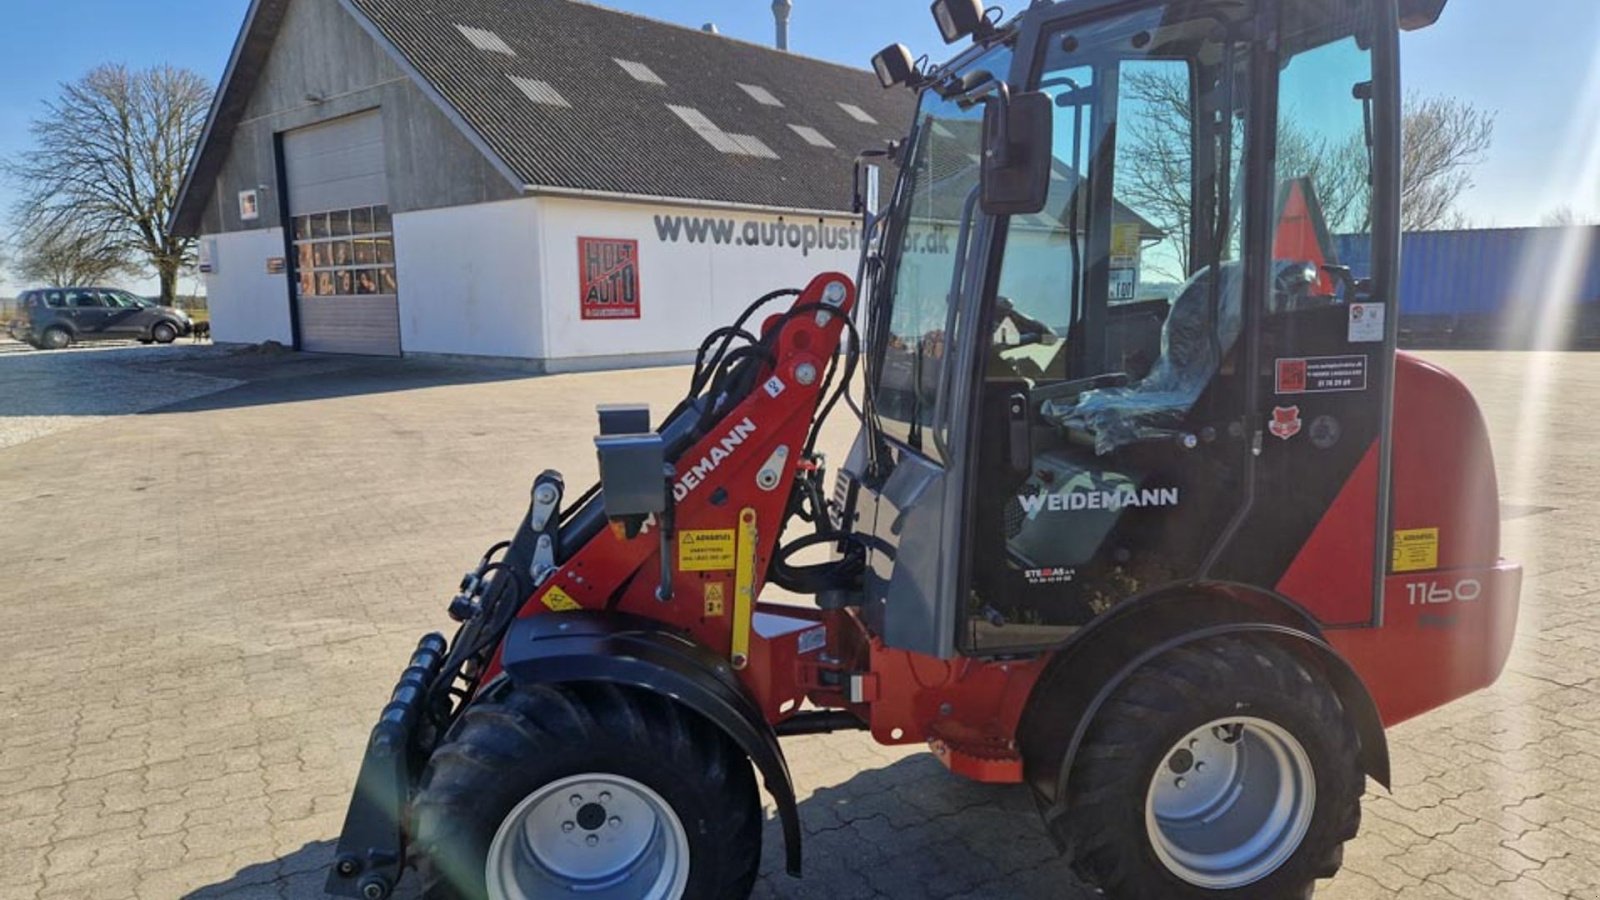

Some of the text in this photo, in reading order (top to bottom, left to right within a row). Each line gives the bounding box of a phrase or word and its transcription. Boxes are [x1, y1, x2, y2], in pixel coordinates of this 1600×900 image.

[585, 264, 635, 304] AUTO
[665, 416, 757, 507] DEMANN
[1018, 487, 1179, 513] WEIDEMANN
[1406, 579, 1481, 605] 1160
